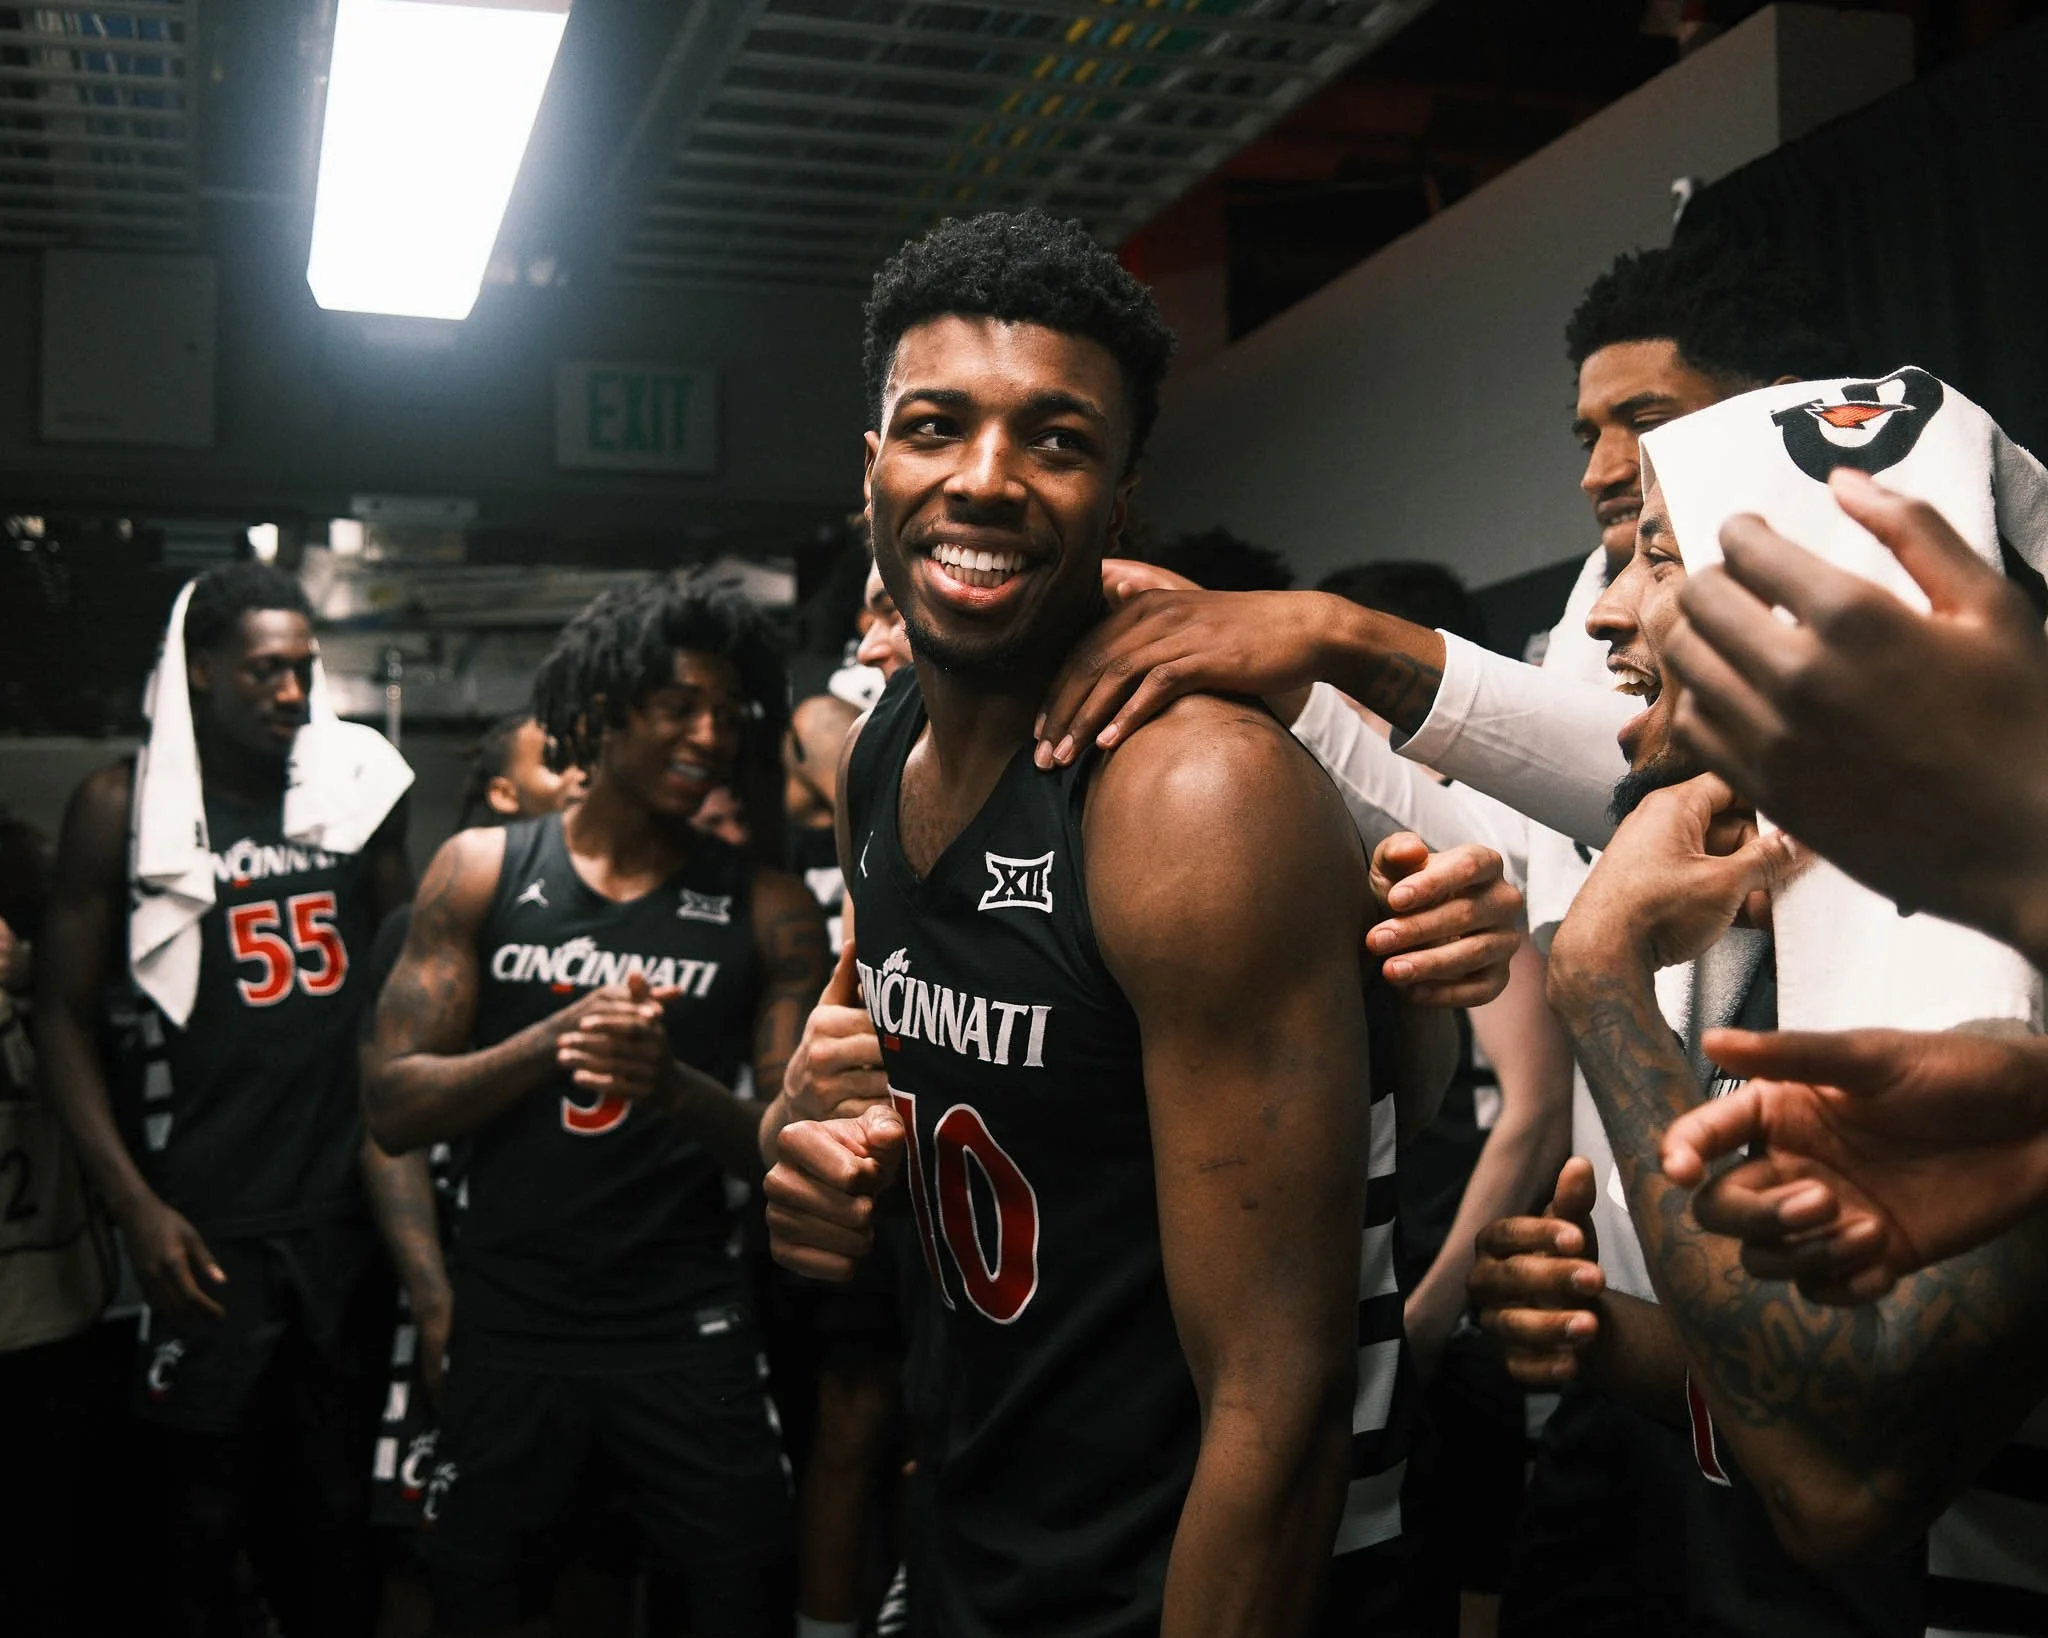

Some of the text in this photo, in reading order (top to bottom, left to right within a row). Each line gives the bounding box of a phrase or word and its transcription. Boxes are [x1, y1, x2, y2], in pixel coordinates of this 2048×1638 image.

[586, 372, 694, 453] EXIT
[227, 890, 348, 1008] 55
[490, 935, 719, 998] CINCINNATI
[856, 947, 1052, 1067] INCINNATI
[888, 1083, 1040, 1325] 10
